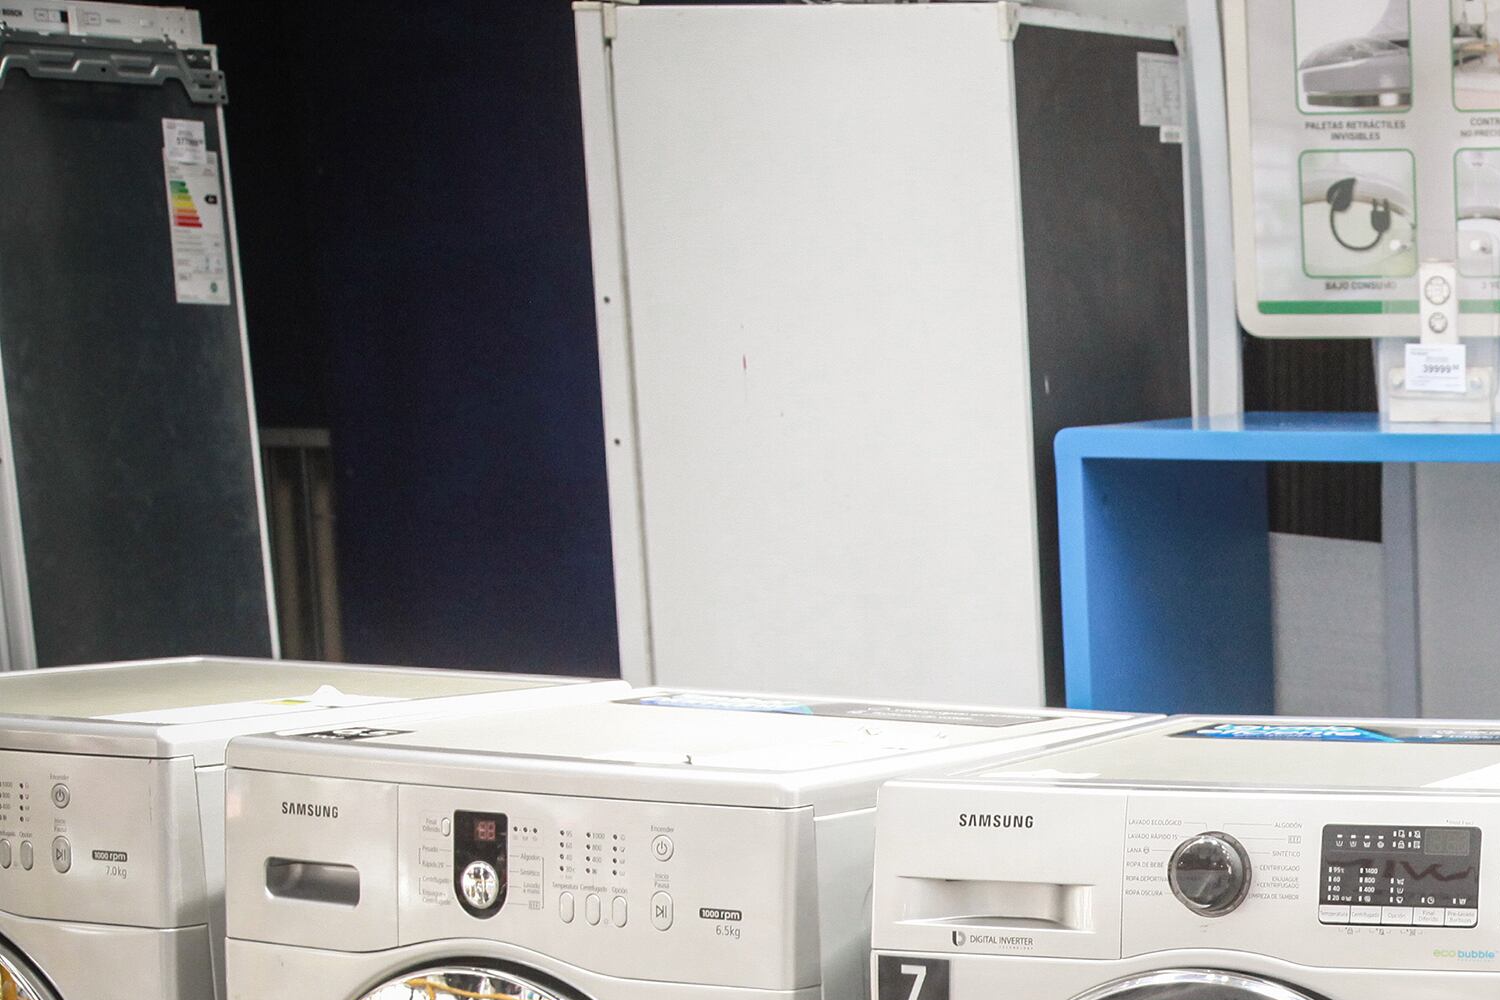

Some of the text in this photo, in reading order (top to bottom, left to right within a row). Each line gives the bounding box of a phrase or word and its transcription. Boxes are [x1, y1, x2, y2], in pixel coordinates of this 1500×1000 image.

[1305, 118, 1406, 130] PALETAS RETRÁCTILES
[1331, 131, 1381, 142] INVISIBLES
[1325, 281, 1349, 290] BAJO
[281, 801, 339, 819] SAMSUNG
[958, 813, 1034, 829] SAMSUNG
[1274, 821, 1302, 829] ALGODÓN
[94, 851, 126, 861] 1000 rpm
[106, 866, 127, 879] 7.0kg
[702, 909, 741, 921] 1000 rpm
[715, 925, 741, 939] 6.5kg
[969, 935, 1034, 945] DIGITAL INVERTER
